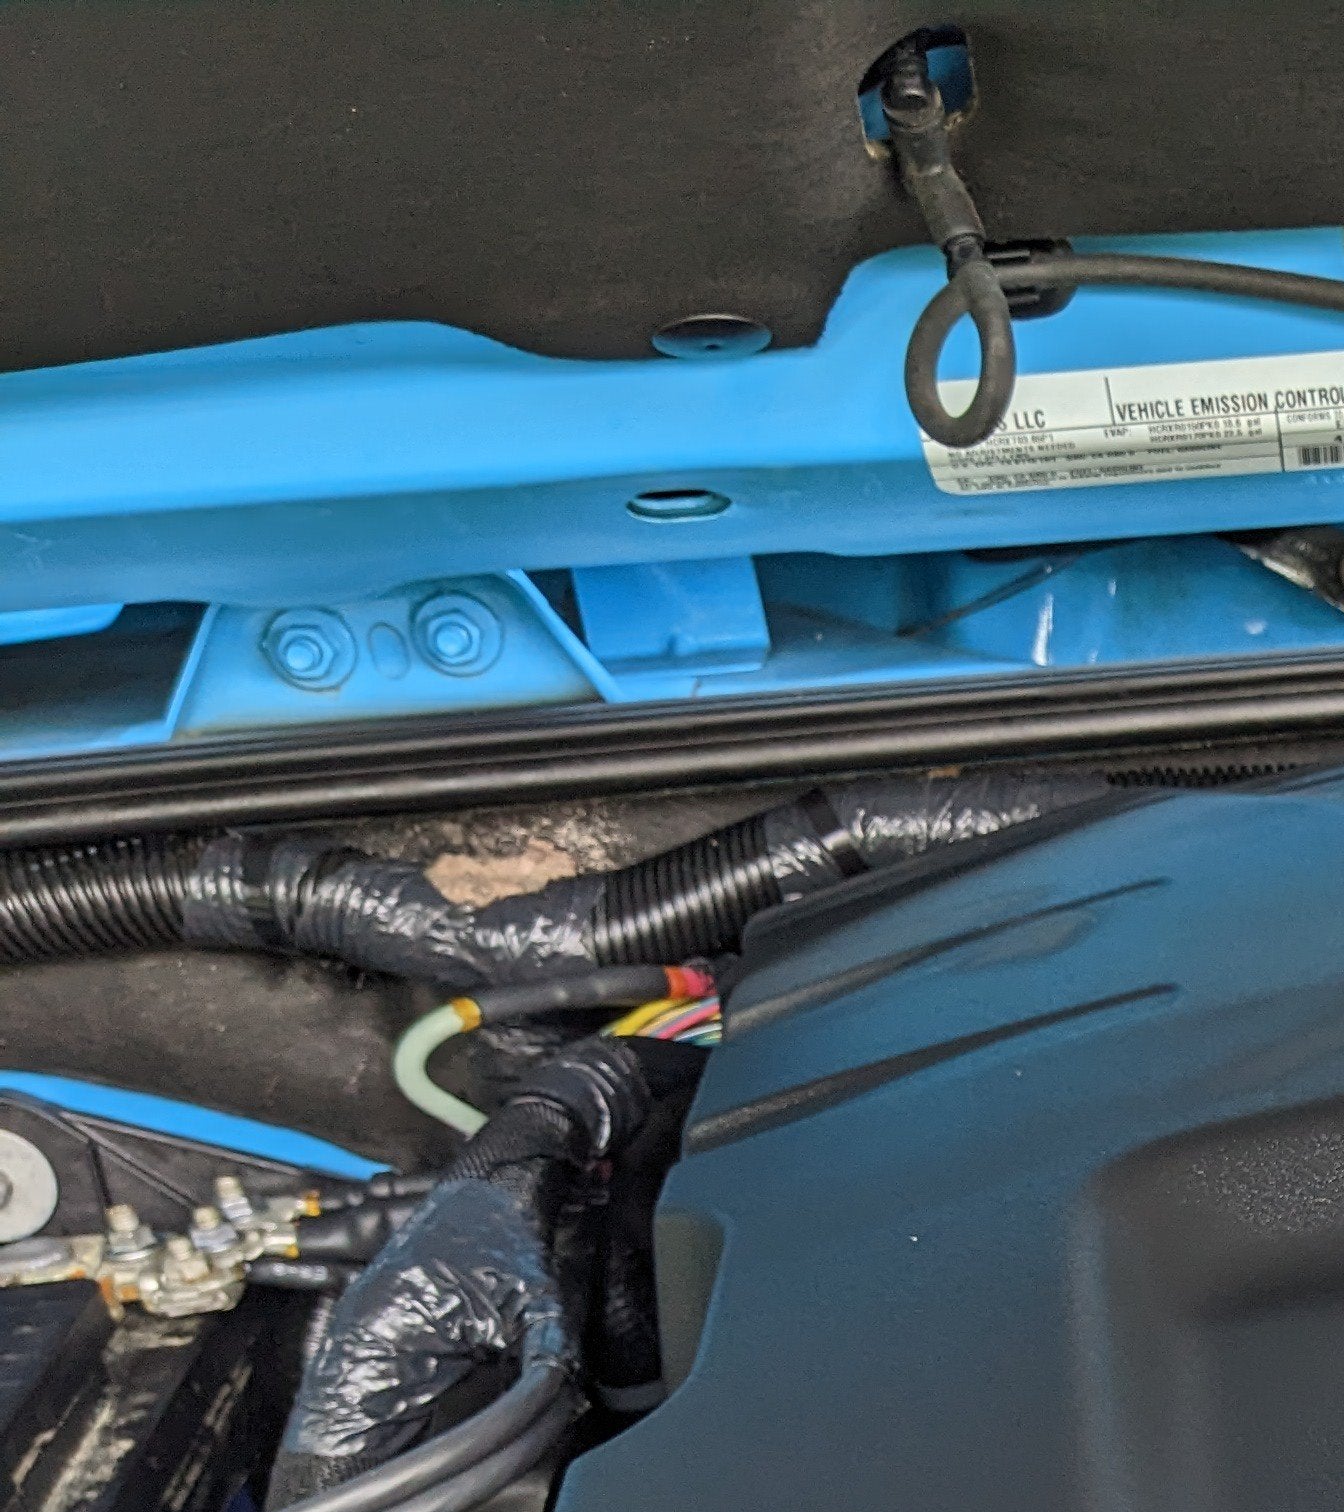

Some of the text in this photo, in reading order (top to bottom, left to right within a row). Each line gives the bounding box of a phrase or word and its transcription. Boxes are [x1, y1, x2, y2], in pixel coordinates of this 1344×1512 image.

[1115, 399, 1185, 421] VEHICLE
[1190, 392, 1268, 415] EMISSION
[1013, 409, 1046, 430] LLC
